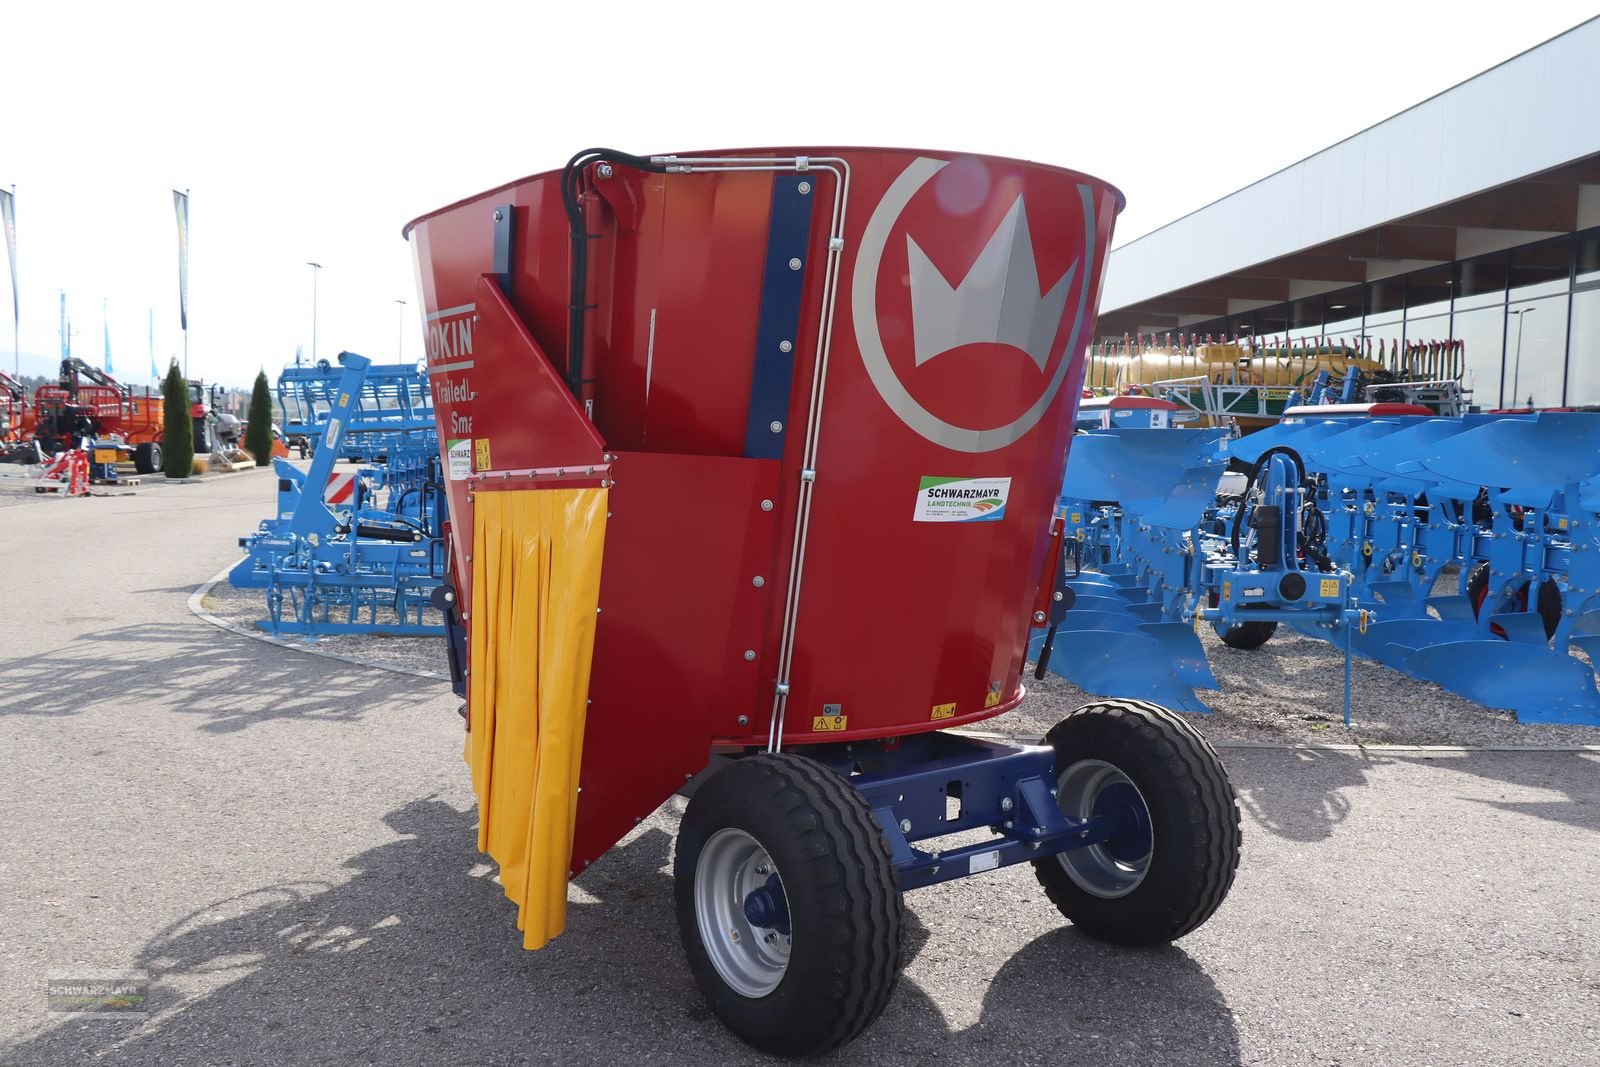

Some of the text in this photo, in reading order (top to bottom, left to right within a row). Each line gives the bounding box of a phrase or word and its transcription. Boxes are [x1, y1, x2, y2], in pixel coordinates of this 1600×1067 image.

[435, 378, 472, 404] TrailedL
[450, 449, 470, 459] SCHWARZ
[927, 488, 1000, 498] SCHWARZMAYR
